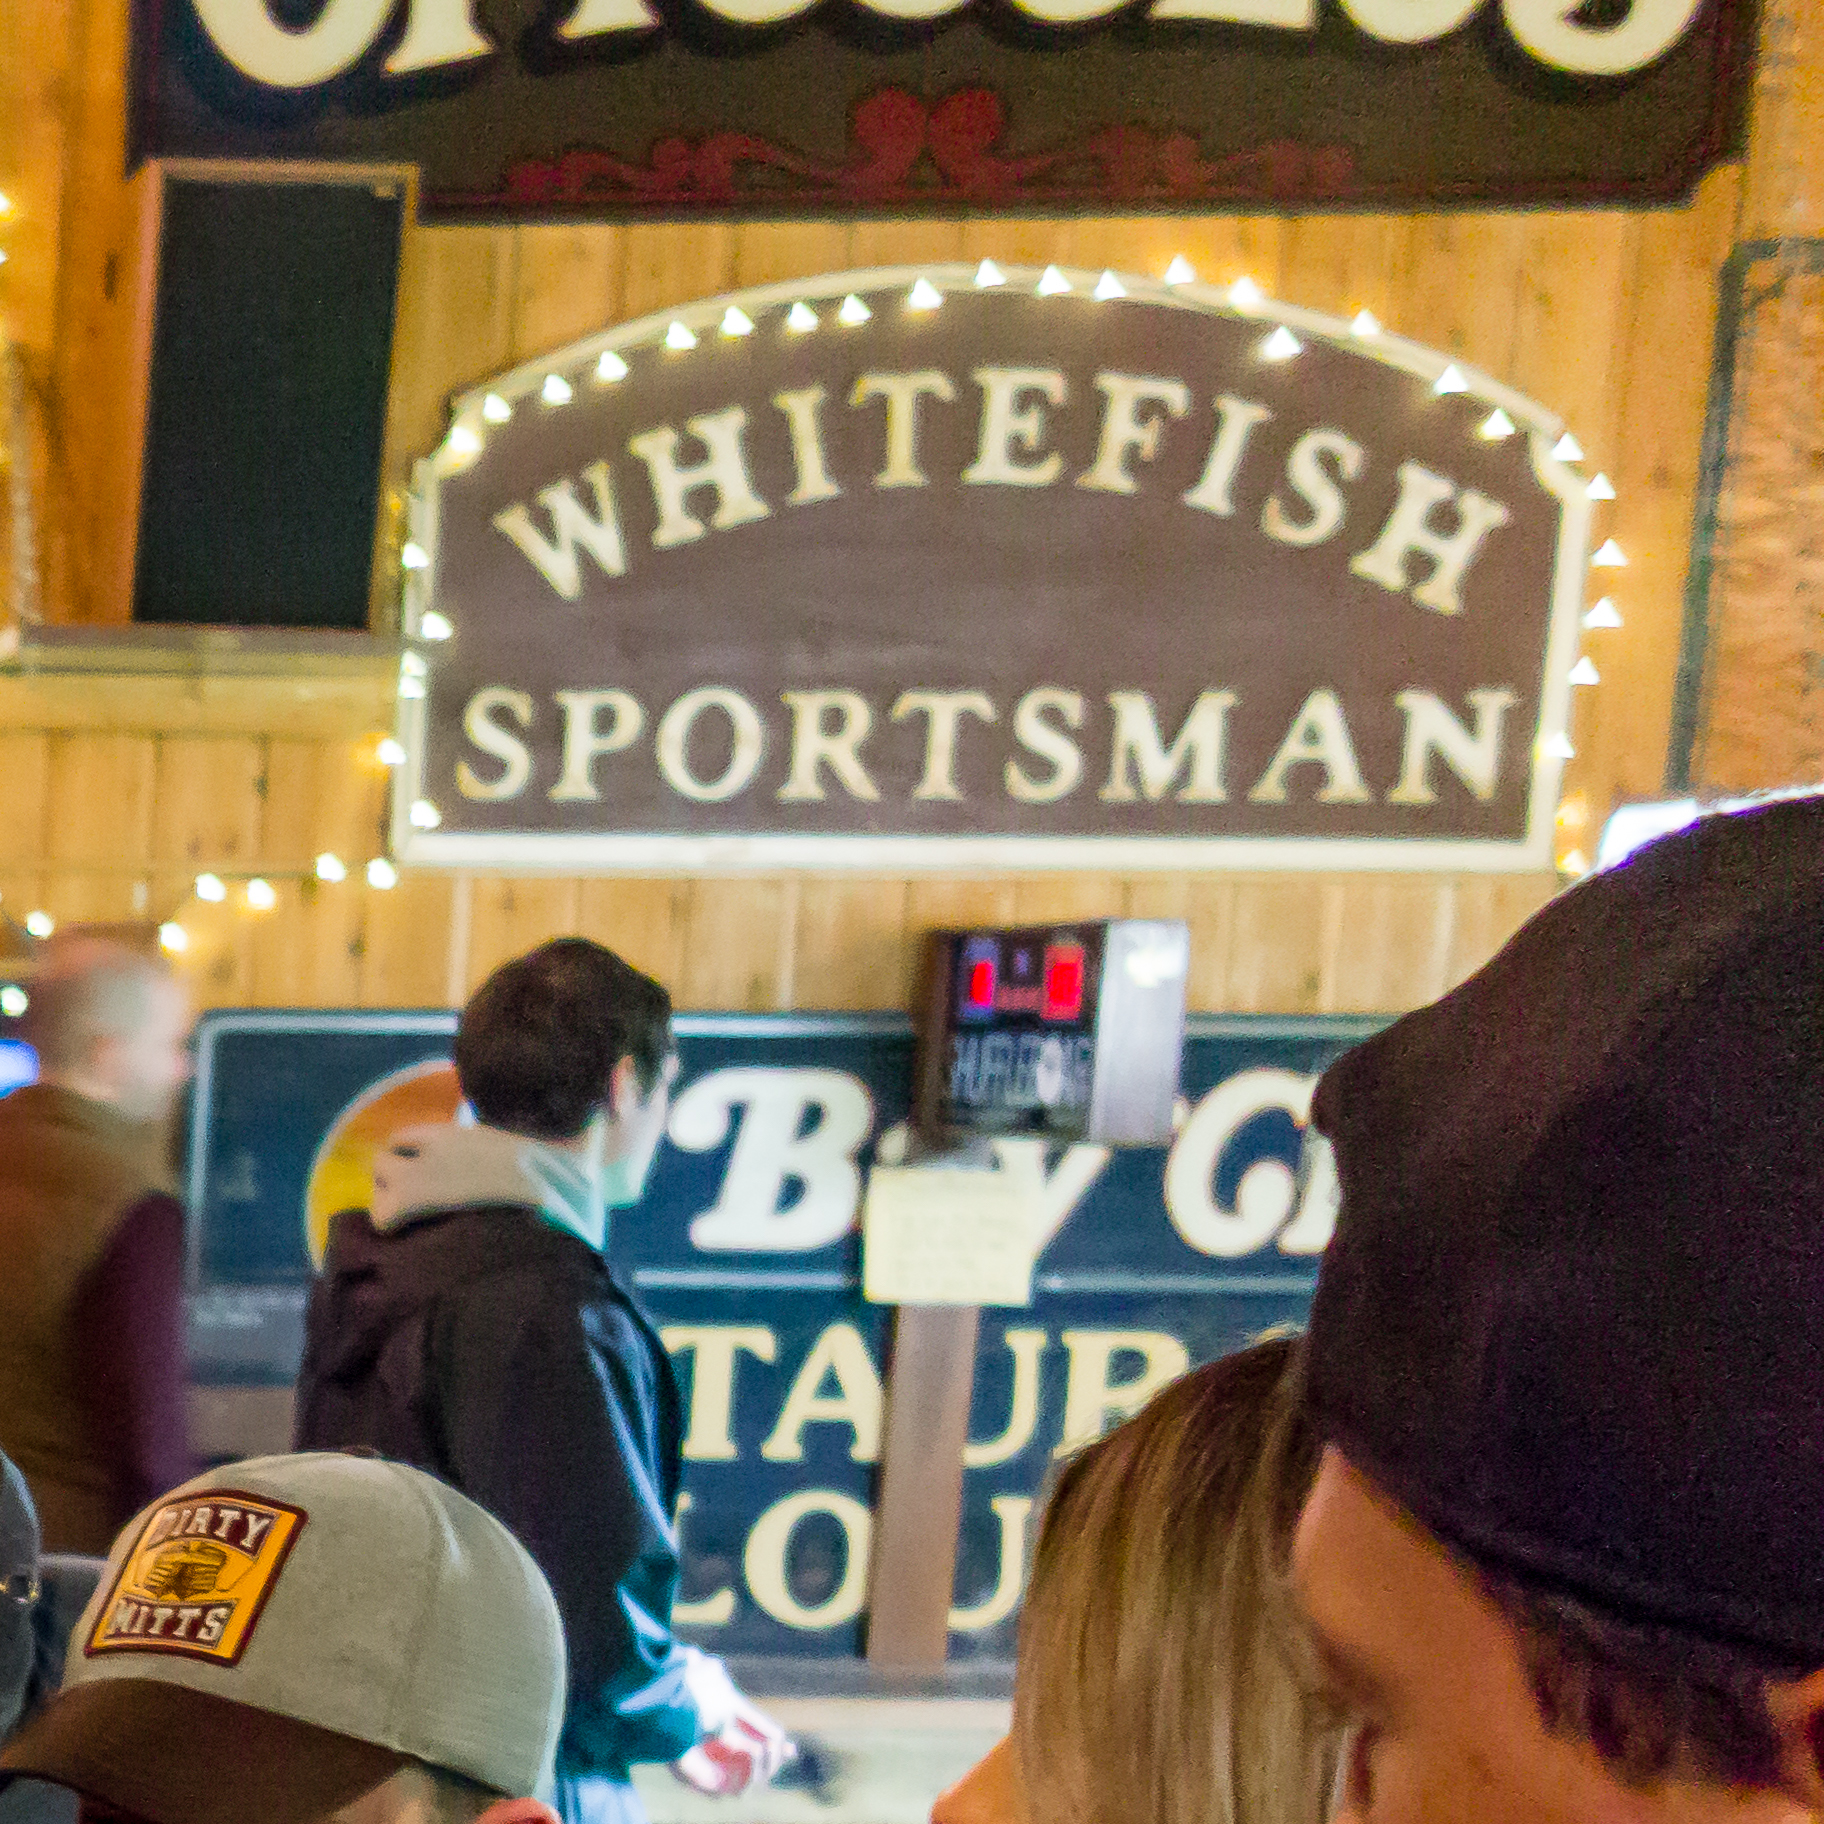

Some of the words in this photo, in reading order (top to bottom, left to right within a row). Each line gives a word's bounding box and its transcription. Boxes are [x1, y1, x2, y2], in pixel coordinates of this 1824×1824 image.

[492, 364, 1510, 618] WHITEFISH
[456, 685, 1515, 806] SPORTSMAN
[149, 1506, 272, 1548] DIRTY
[107, 1599, 231, 1642] MITTS
